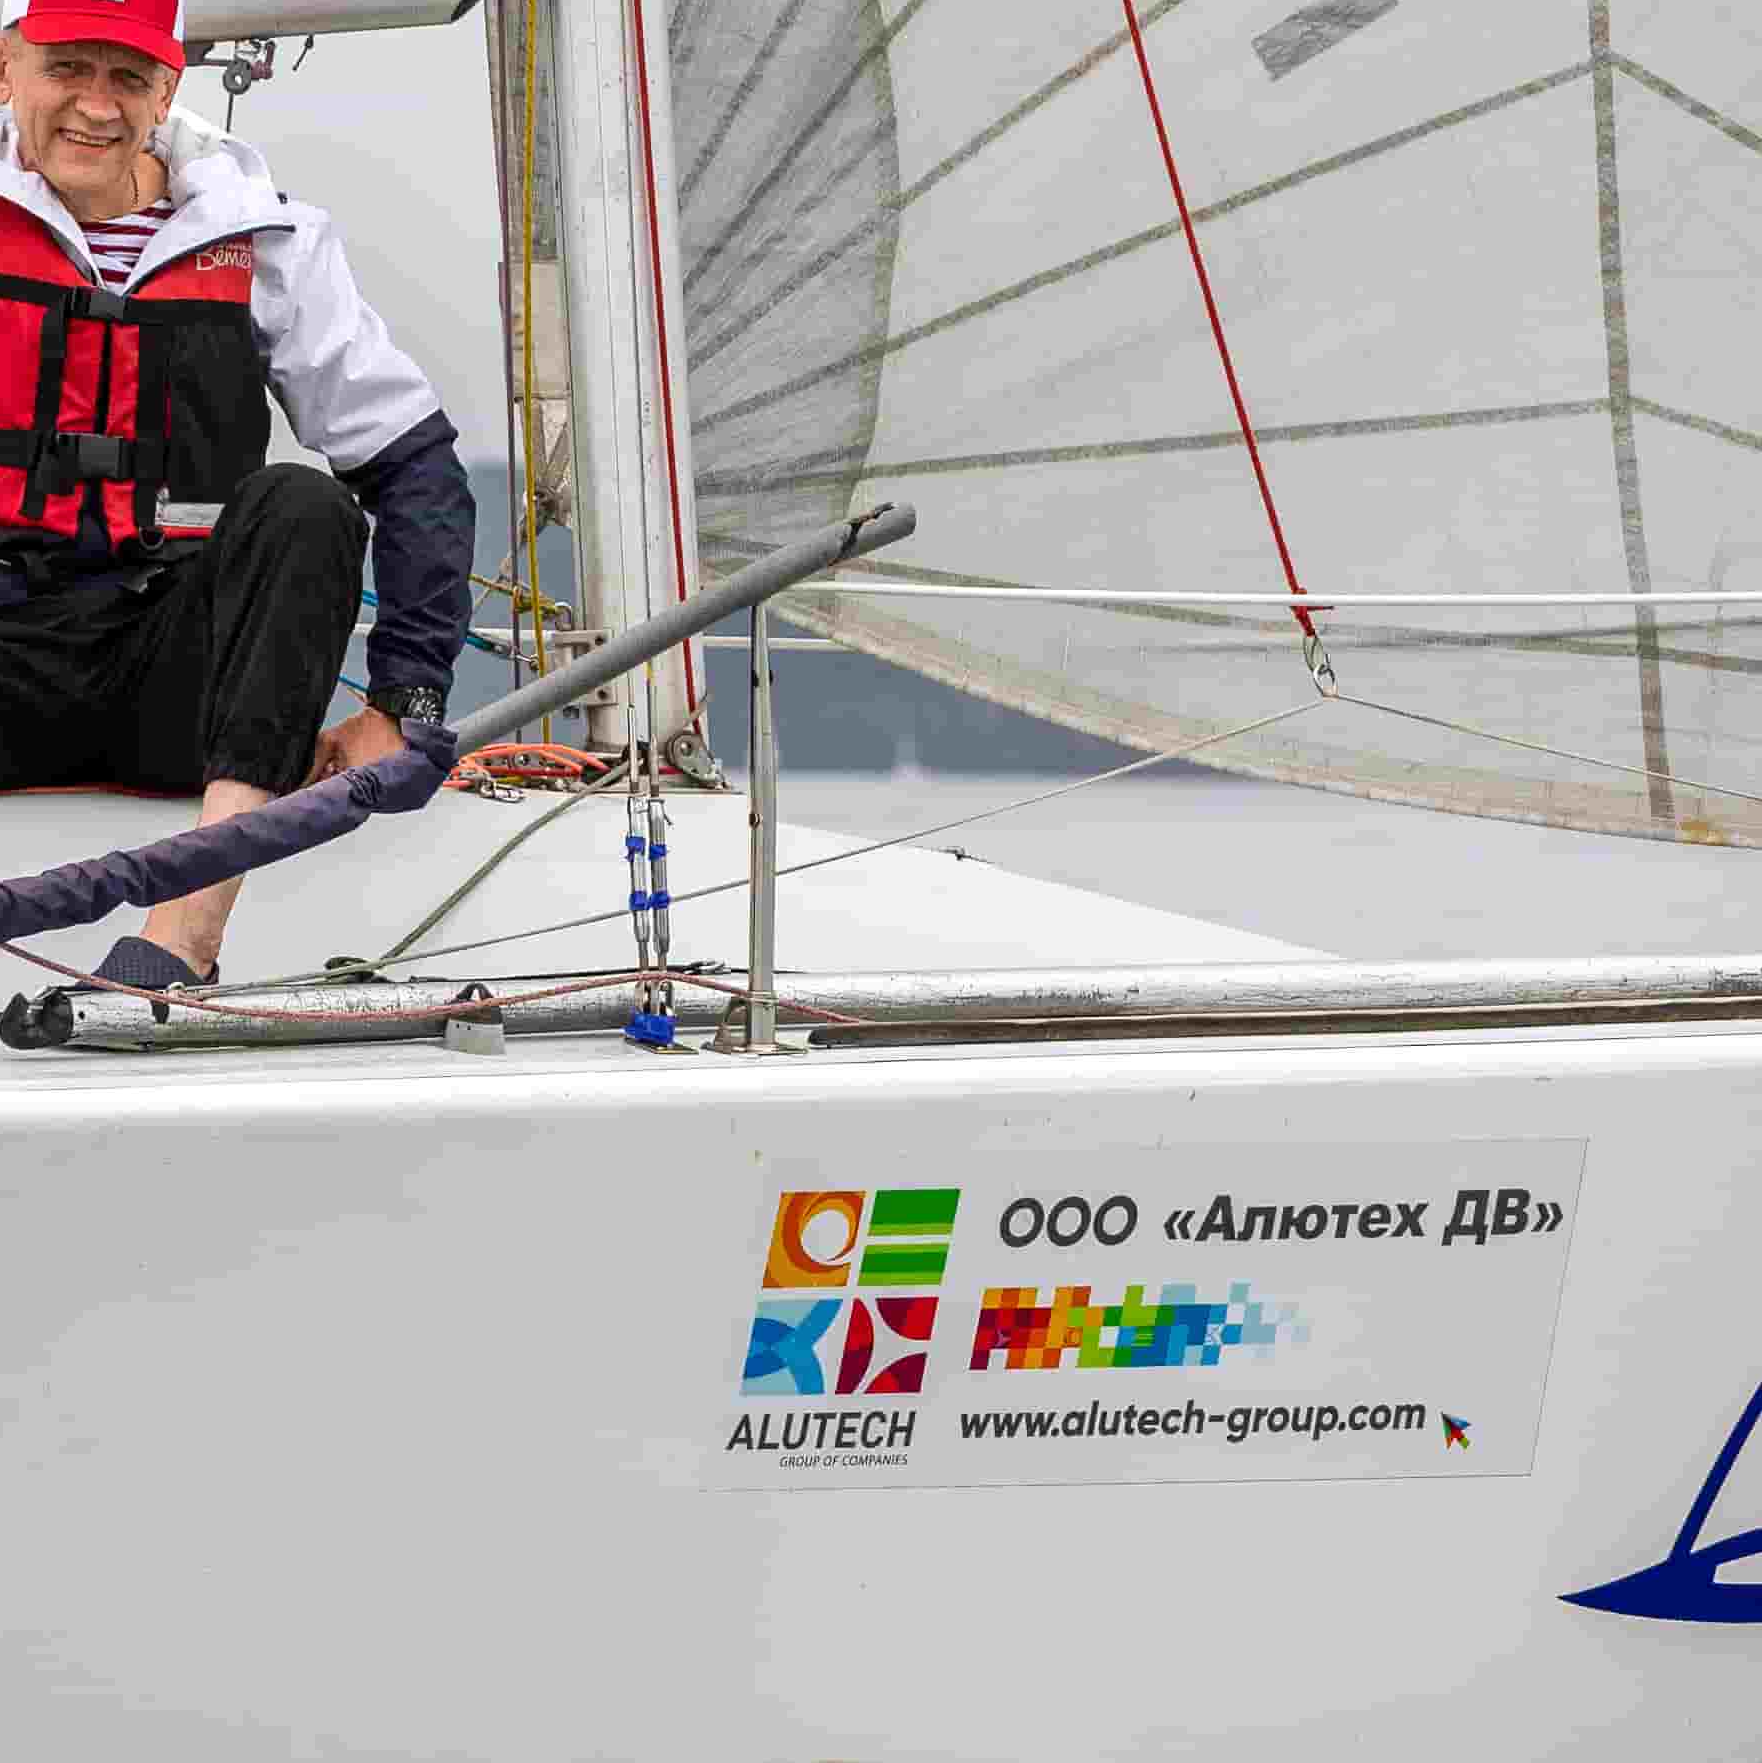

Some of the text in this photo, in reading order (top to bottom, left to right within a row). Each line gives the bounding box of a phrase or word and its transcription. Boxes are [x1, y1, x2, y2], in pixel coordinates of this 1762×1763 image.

[999, 1188, 1564, 1248] ООО «Алютех ДВ»
[725, 1411, 916, 1451] ALUTECH
[960, 1399, 1427, 1444] www.alutech-group.com
[779, 1452, 908, 1469] GROUP OF COMPANIES
